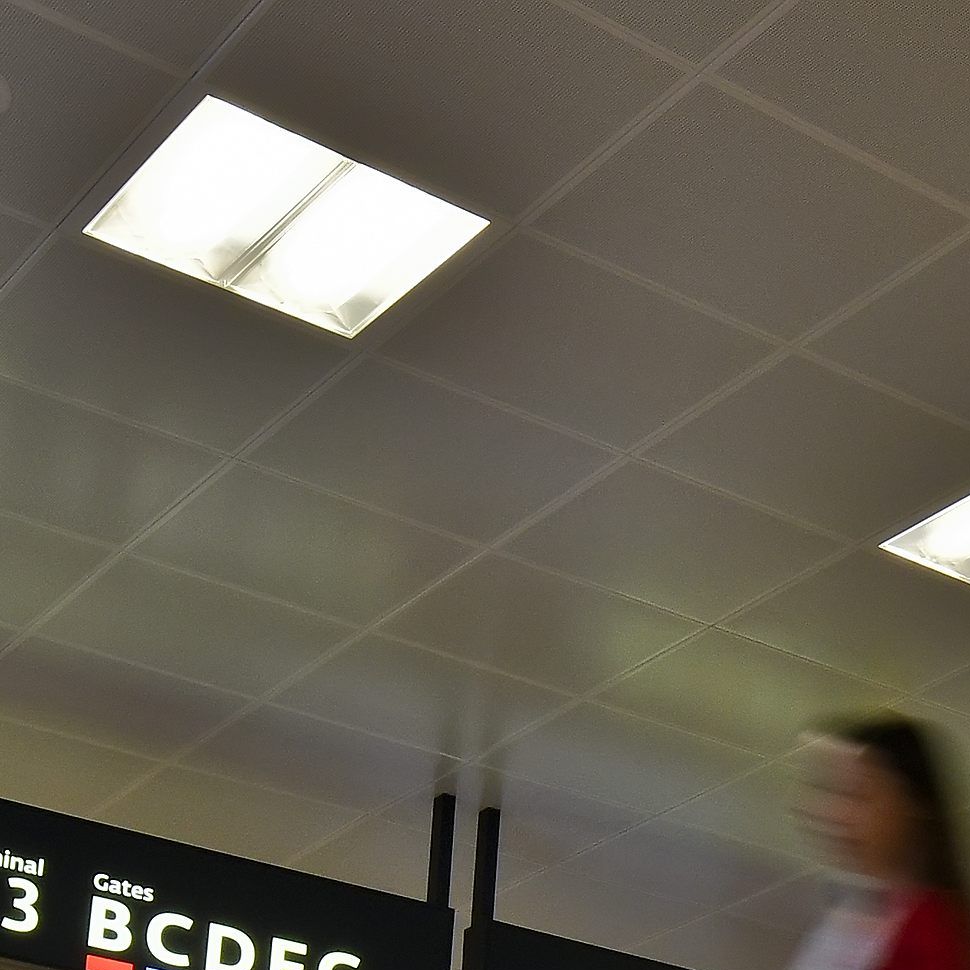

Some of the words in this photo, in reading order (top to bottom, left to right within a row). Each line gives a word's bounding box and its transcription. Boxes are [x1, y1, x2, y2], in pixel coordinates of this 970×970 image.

[0, 850, 45, 876] inal
[93, 873, 155, 902] Gates
[1, 876, 39, 933] 3
